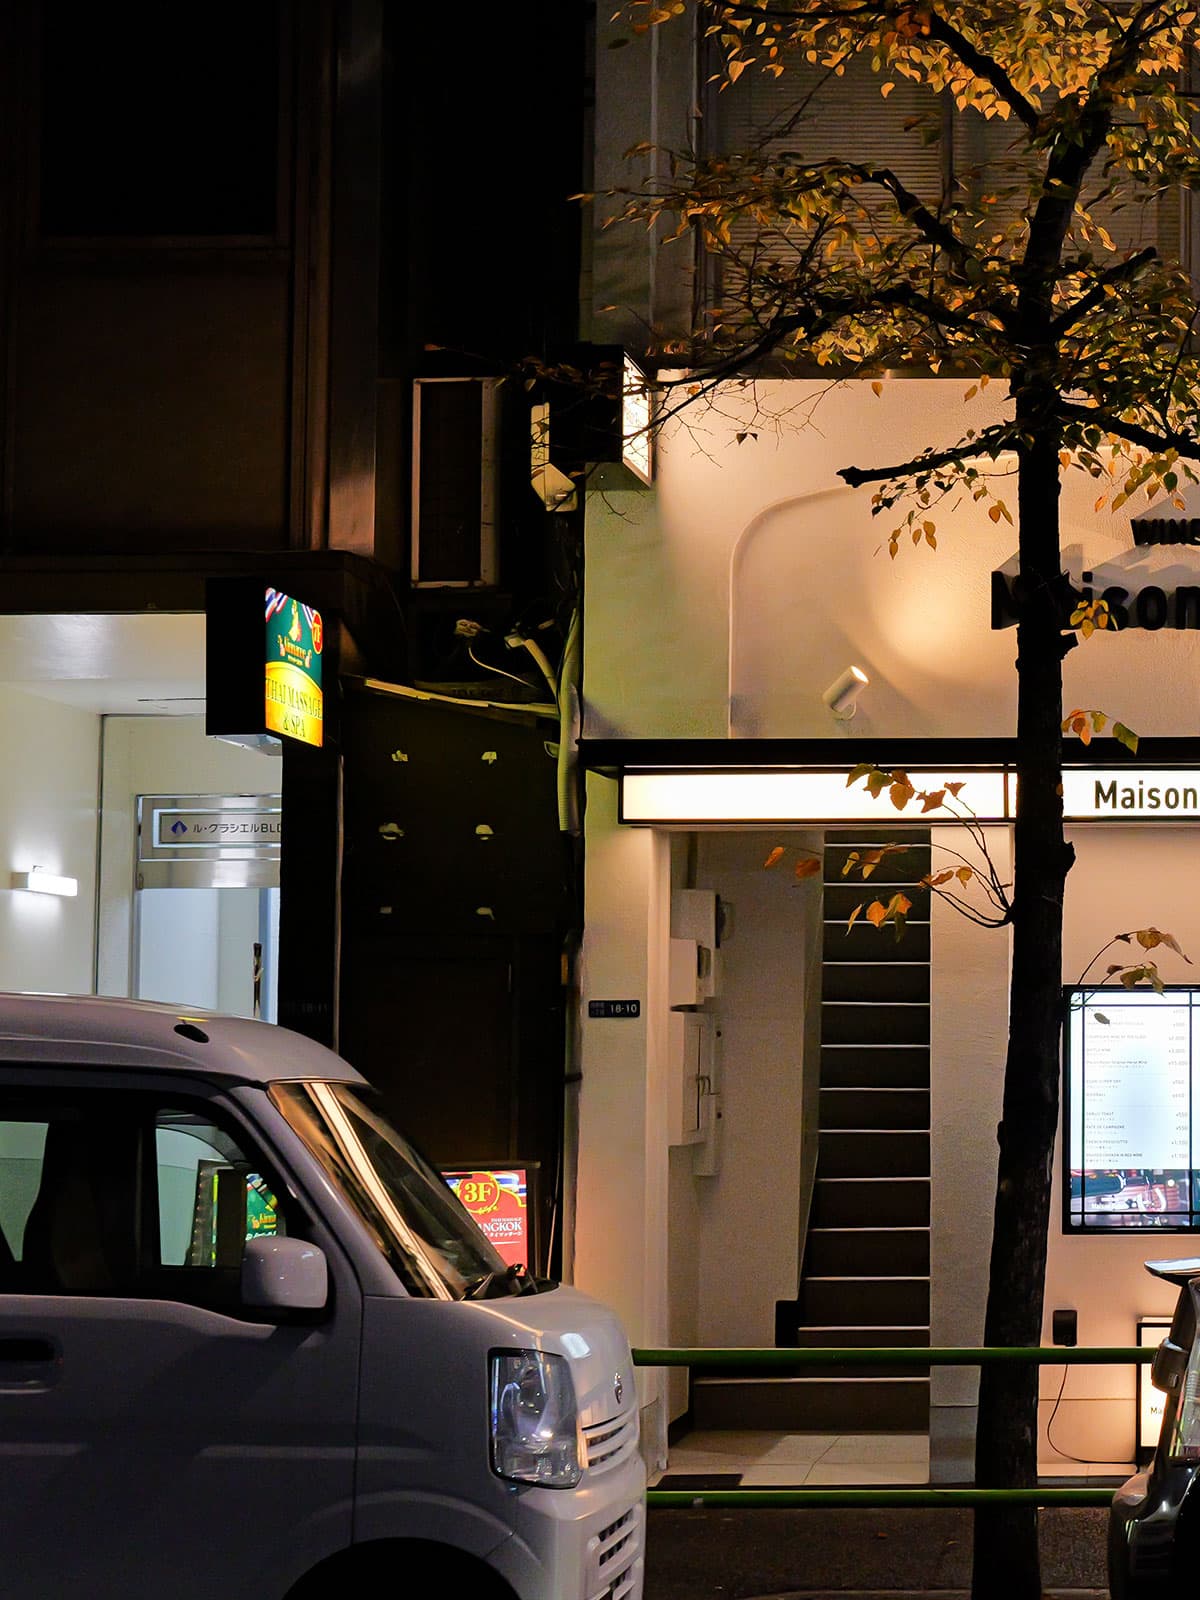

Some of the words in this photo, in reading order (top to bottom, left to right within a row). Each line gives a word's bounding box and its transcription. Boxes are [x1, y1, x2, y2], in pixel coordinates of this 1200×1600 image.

[266, 678, 286, 704] THAI
[288, 686, 322, 719] MASSAGE
[290, 715, 307, 738] SPA
[1094, 780, 1198, 809] Maison
[611, 1003, 637, 1014] 18-10
[464, 1182, 495, 1202] 3F
